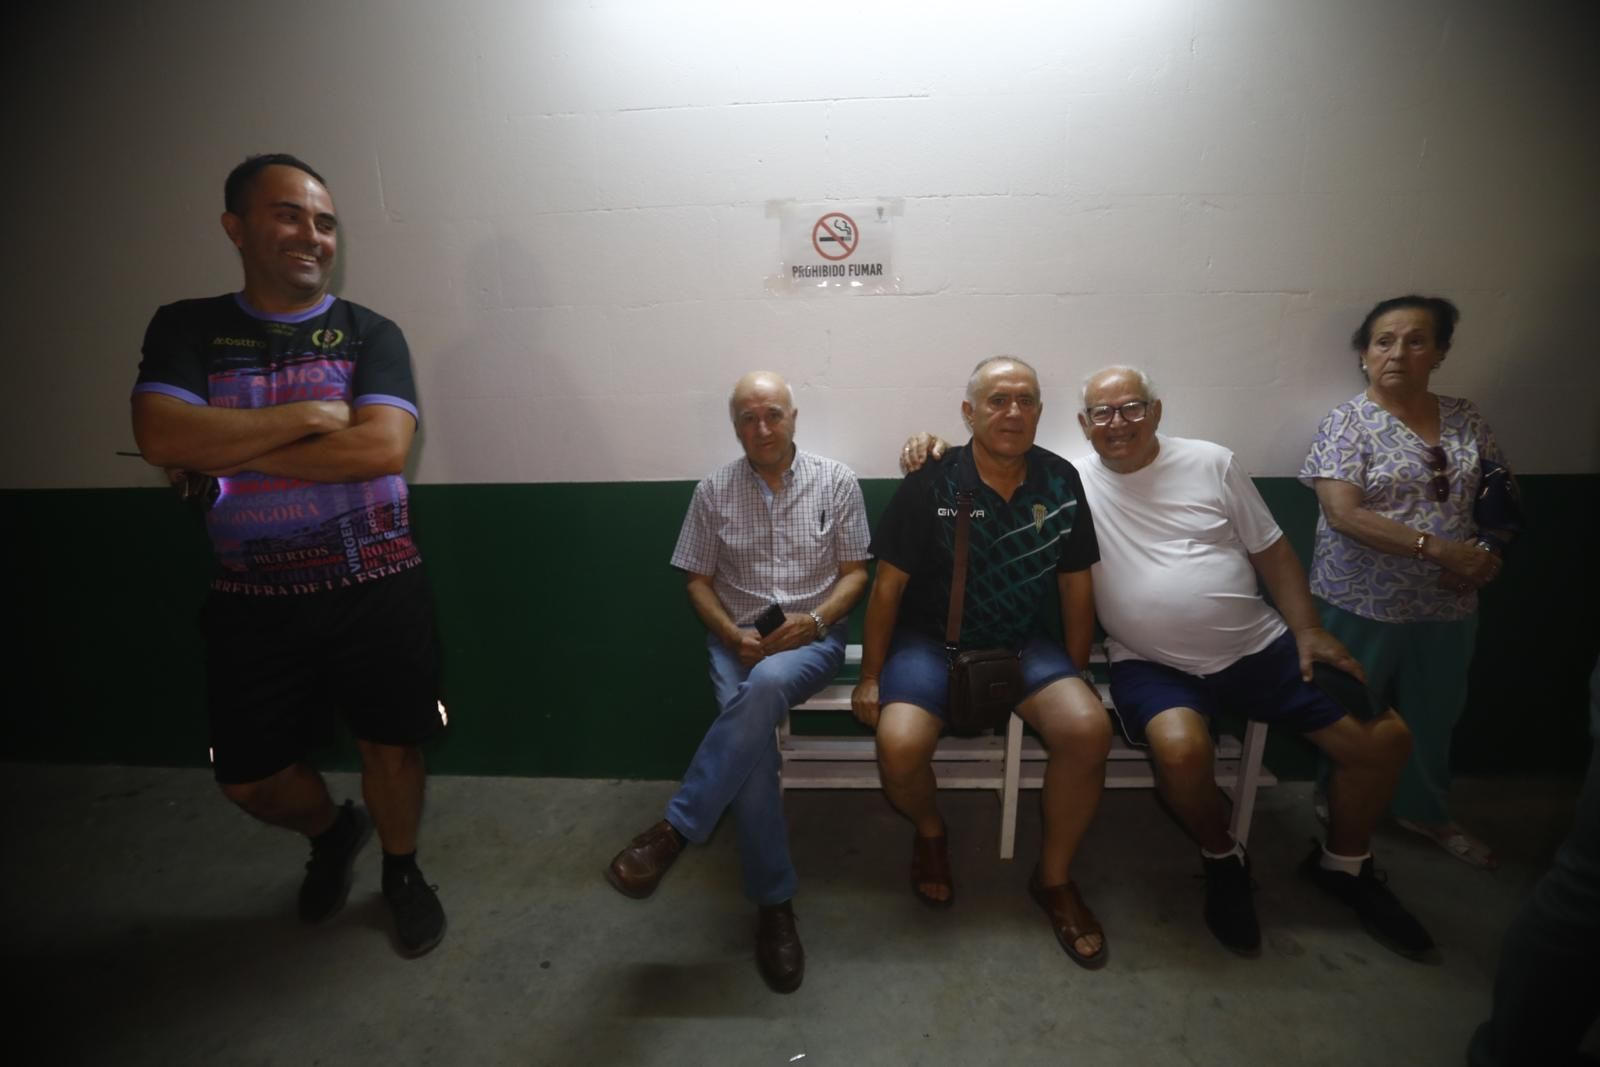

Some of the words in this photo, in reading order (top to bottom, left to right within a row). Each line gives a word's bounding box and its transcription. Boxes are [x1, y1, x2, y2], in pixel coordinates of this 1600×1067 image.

[792, 264, 846, 279] PROHIBIDO
[848, 263, 883, 277] FUMAR
[937, 507, 985, 518] GIVVA
[340, 516, 362, 574] VIRGEN
[253, 546, 330, 565] HUERTOS
[292, 581, 321, 596] DE
